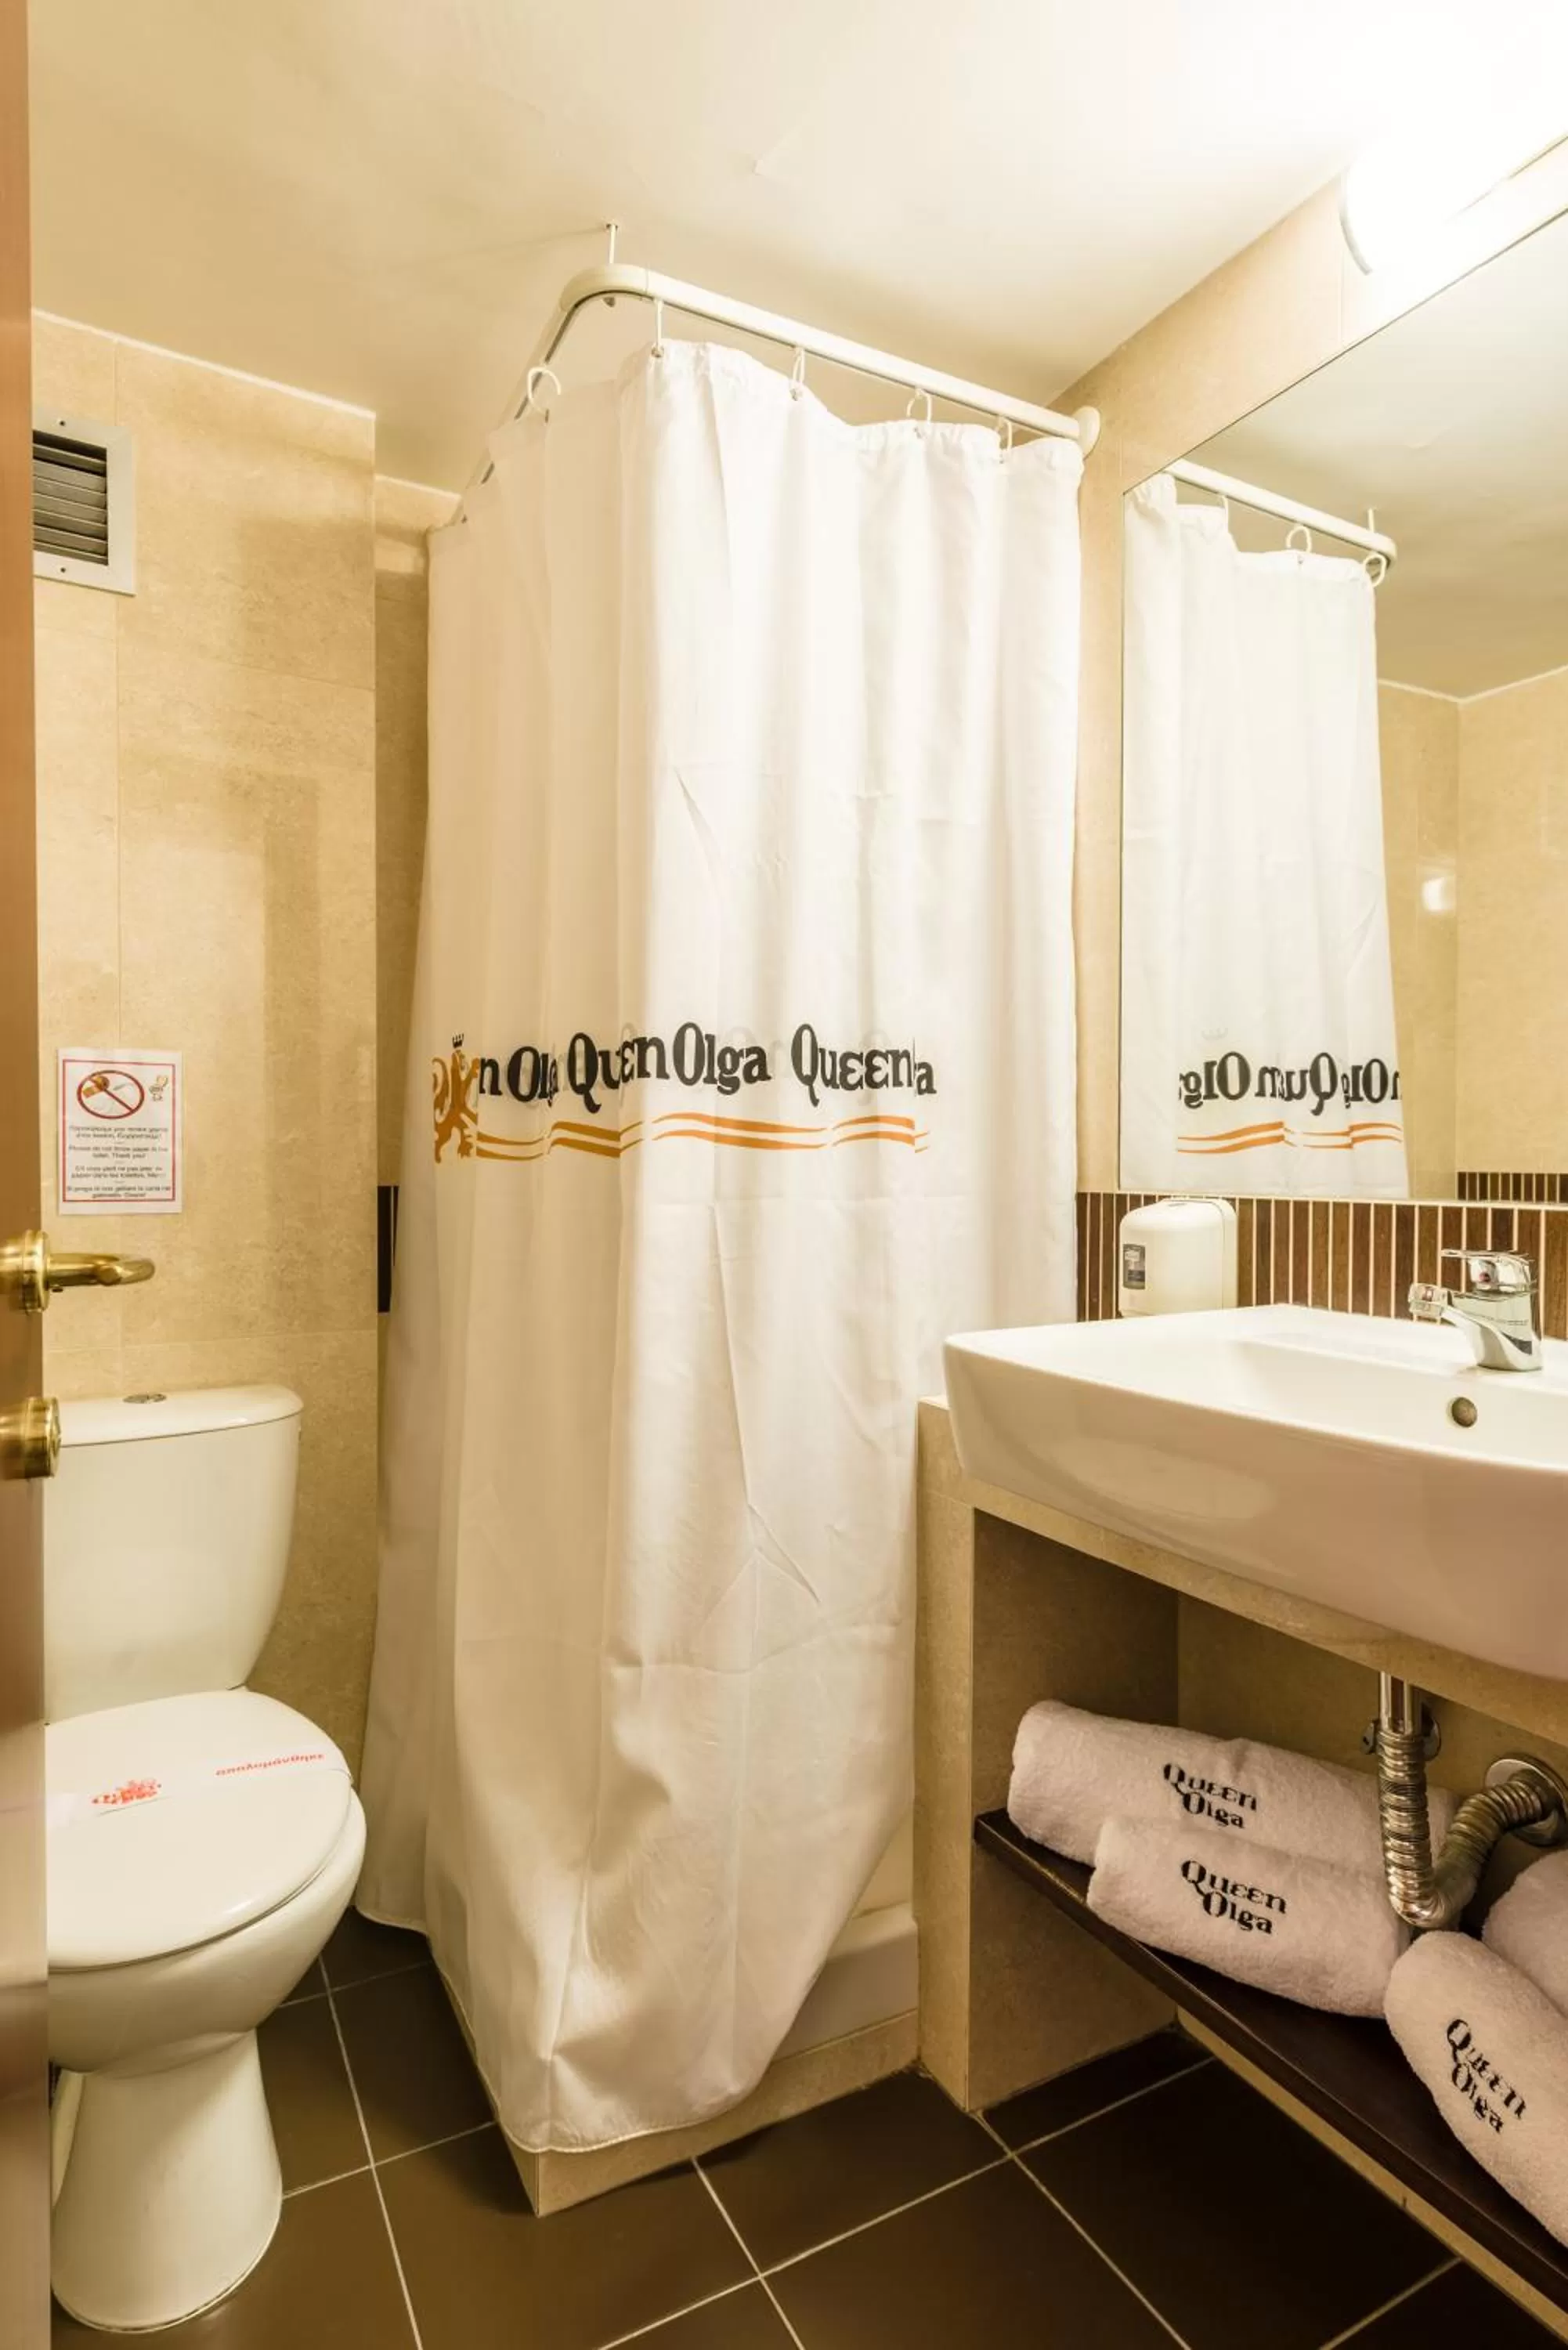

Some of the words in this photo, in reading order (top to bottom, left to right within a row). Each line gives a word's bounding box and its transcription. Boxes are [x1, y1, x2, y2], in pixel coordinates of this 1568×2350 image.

[672, 1021, 772, 1097] Olga
[790, 1023, 913, 1107] Queen
[1163, 1762, 1258, 1812] Queen
[1182, 1791, 1245, 1829] Olga
[1180, 1860, 1287, 1914] Queen
[1202, 1890, 1274, 1935] Olga
[1447, 2019, 1526, 2120] Queen
[1451, 2063, 1504, 2133] Olga
